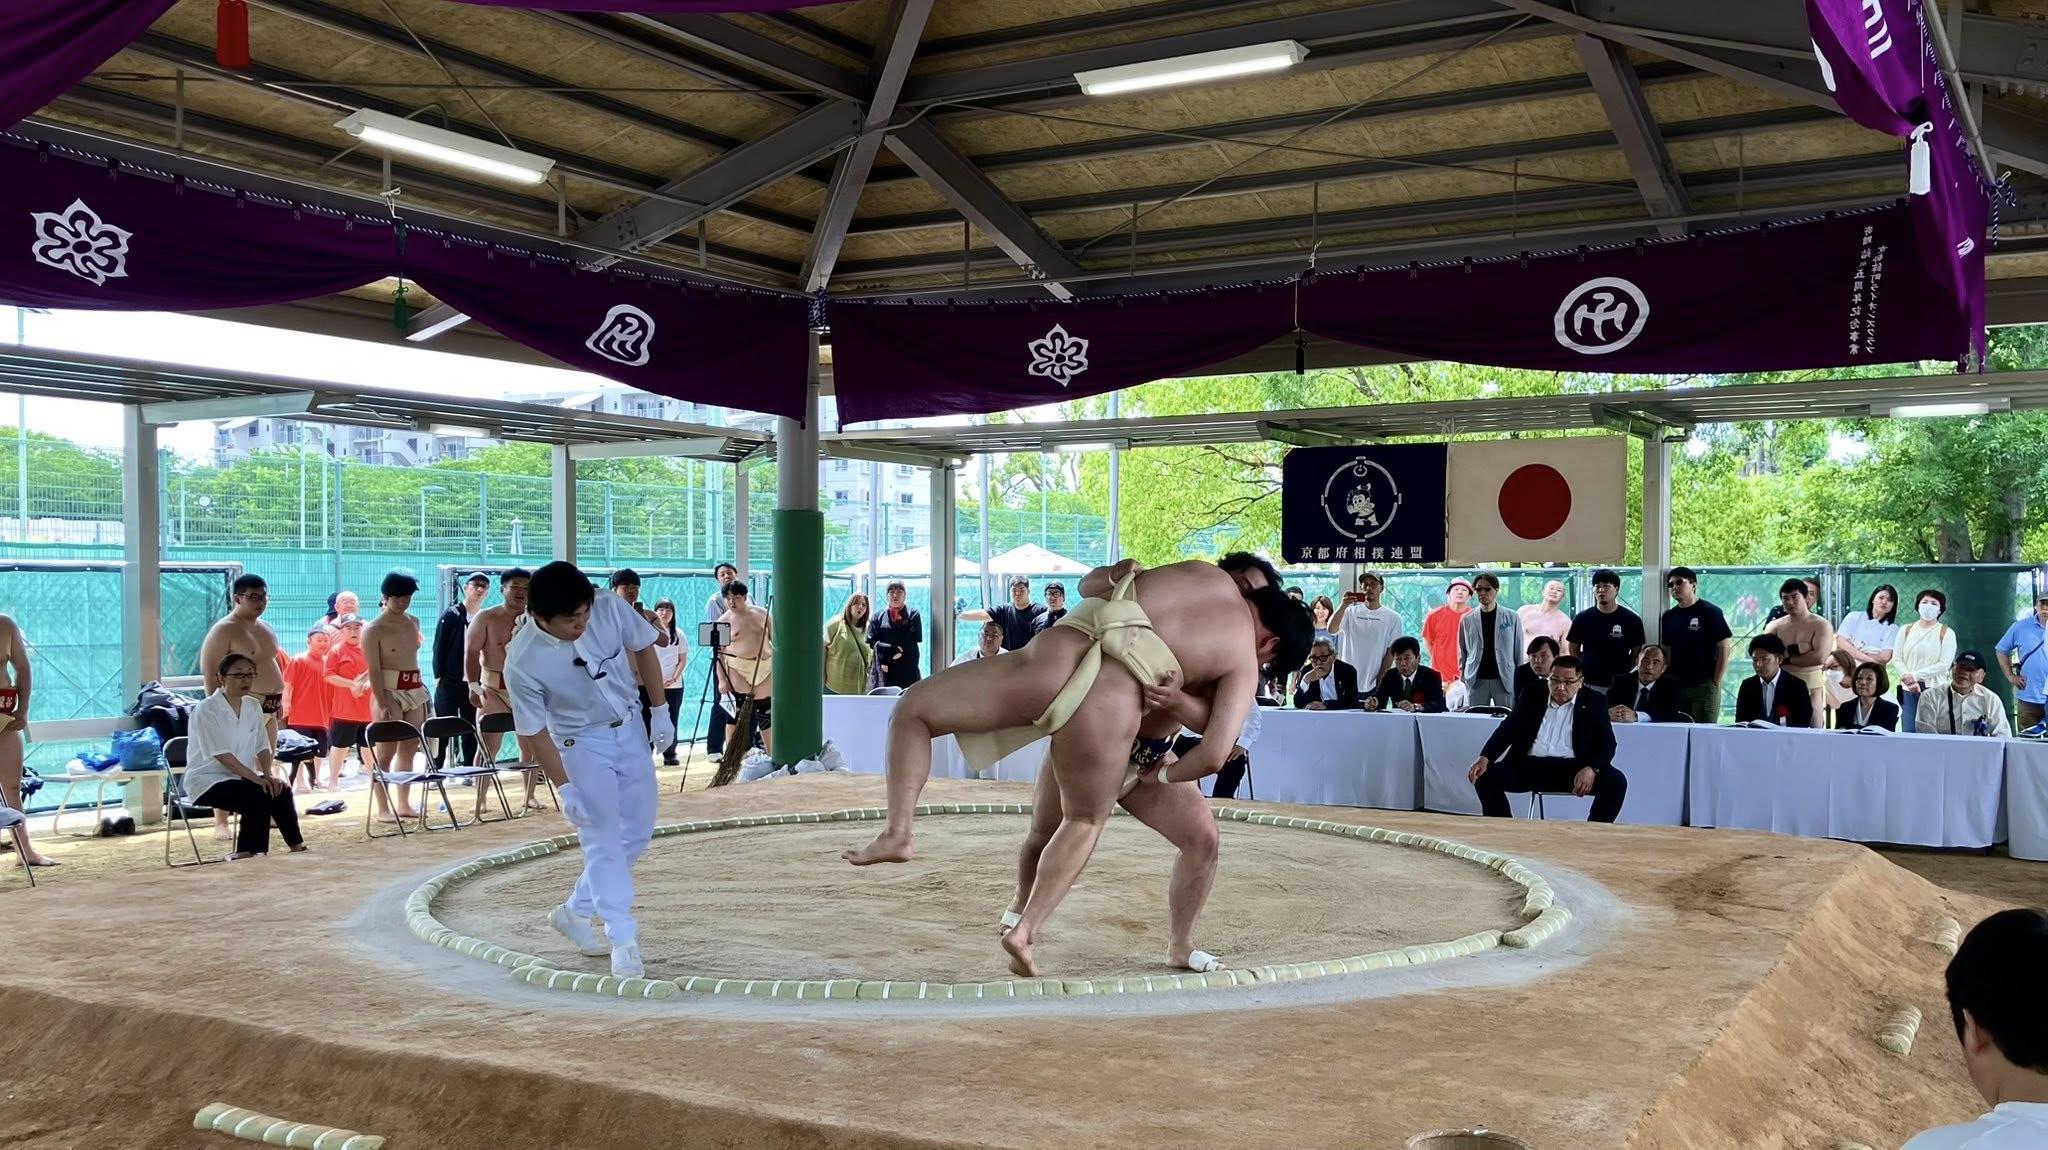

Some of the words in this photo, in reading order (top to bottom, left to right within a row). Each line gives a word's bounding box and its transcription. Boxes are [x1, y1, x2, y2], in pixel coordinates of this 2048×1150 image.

[1301, 546, 1423, 560] 京都府相撲連盟
